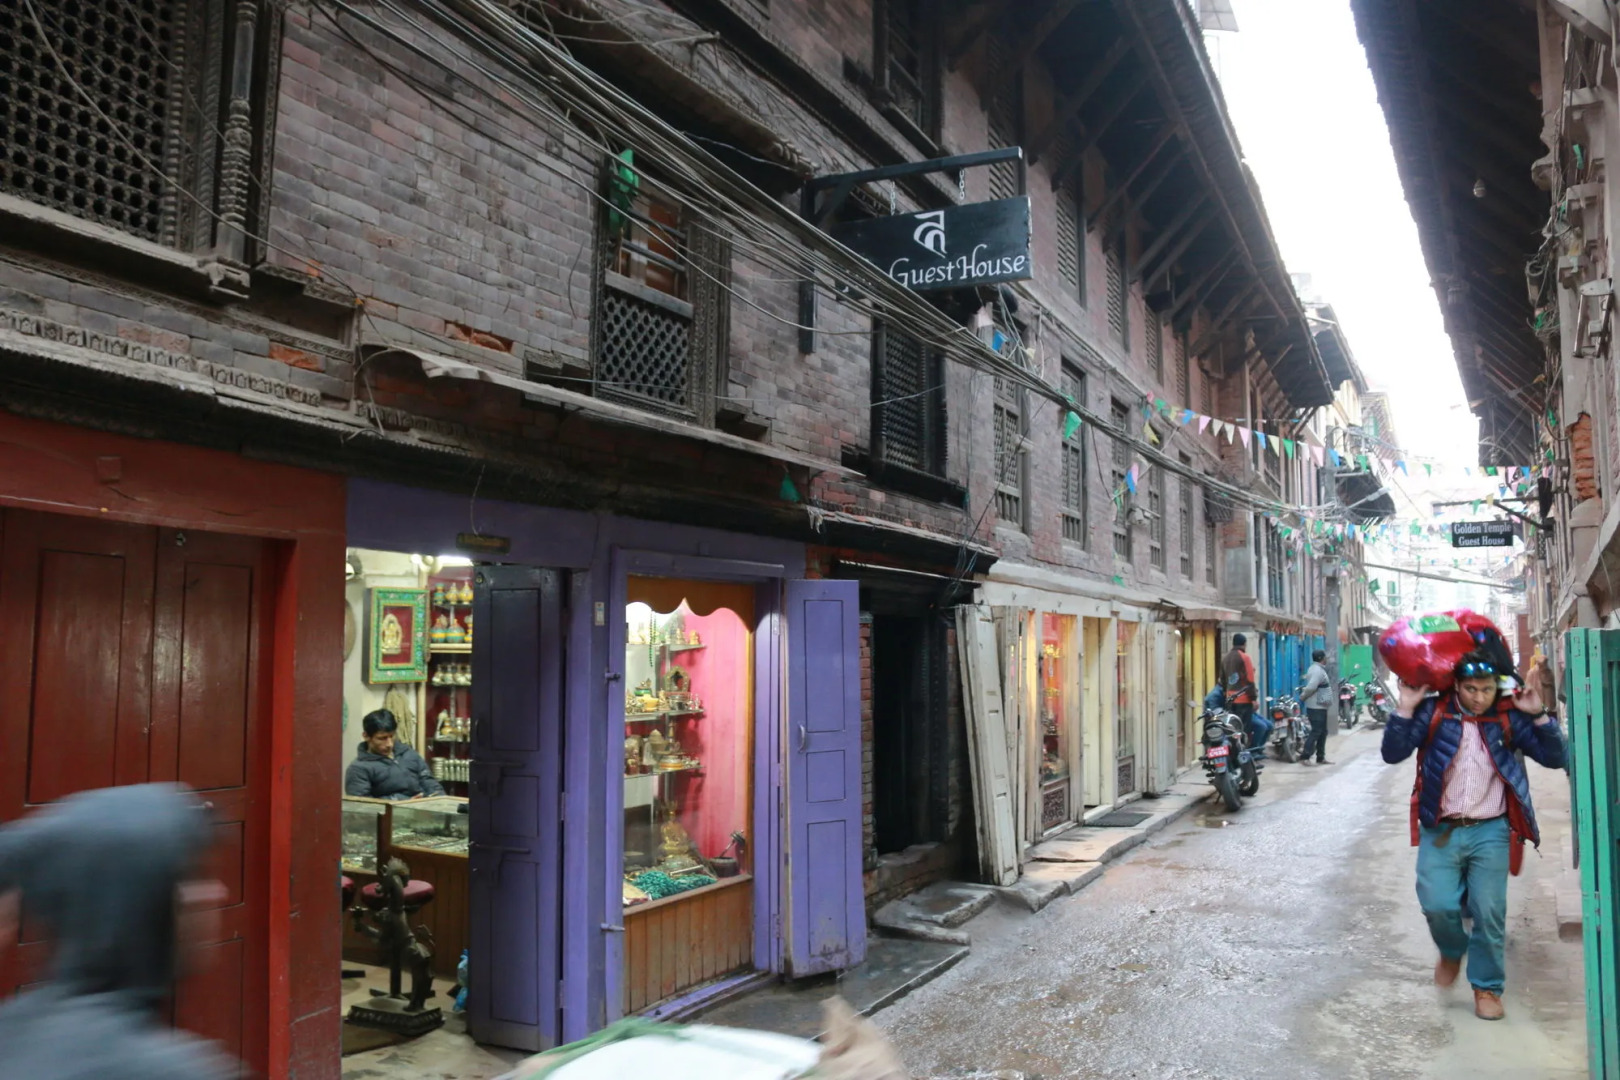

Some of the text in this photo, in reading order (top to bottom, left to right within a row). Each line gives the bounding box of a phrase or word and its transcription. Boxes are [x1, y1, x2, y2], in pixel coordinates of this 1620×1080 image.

[889, 257, 955, 287] Guest
[956, 244, 1026, 280] House
[1454, 523, 1511, 534] Golden Temple
[1458, 536, 1505, 546] Guest House
